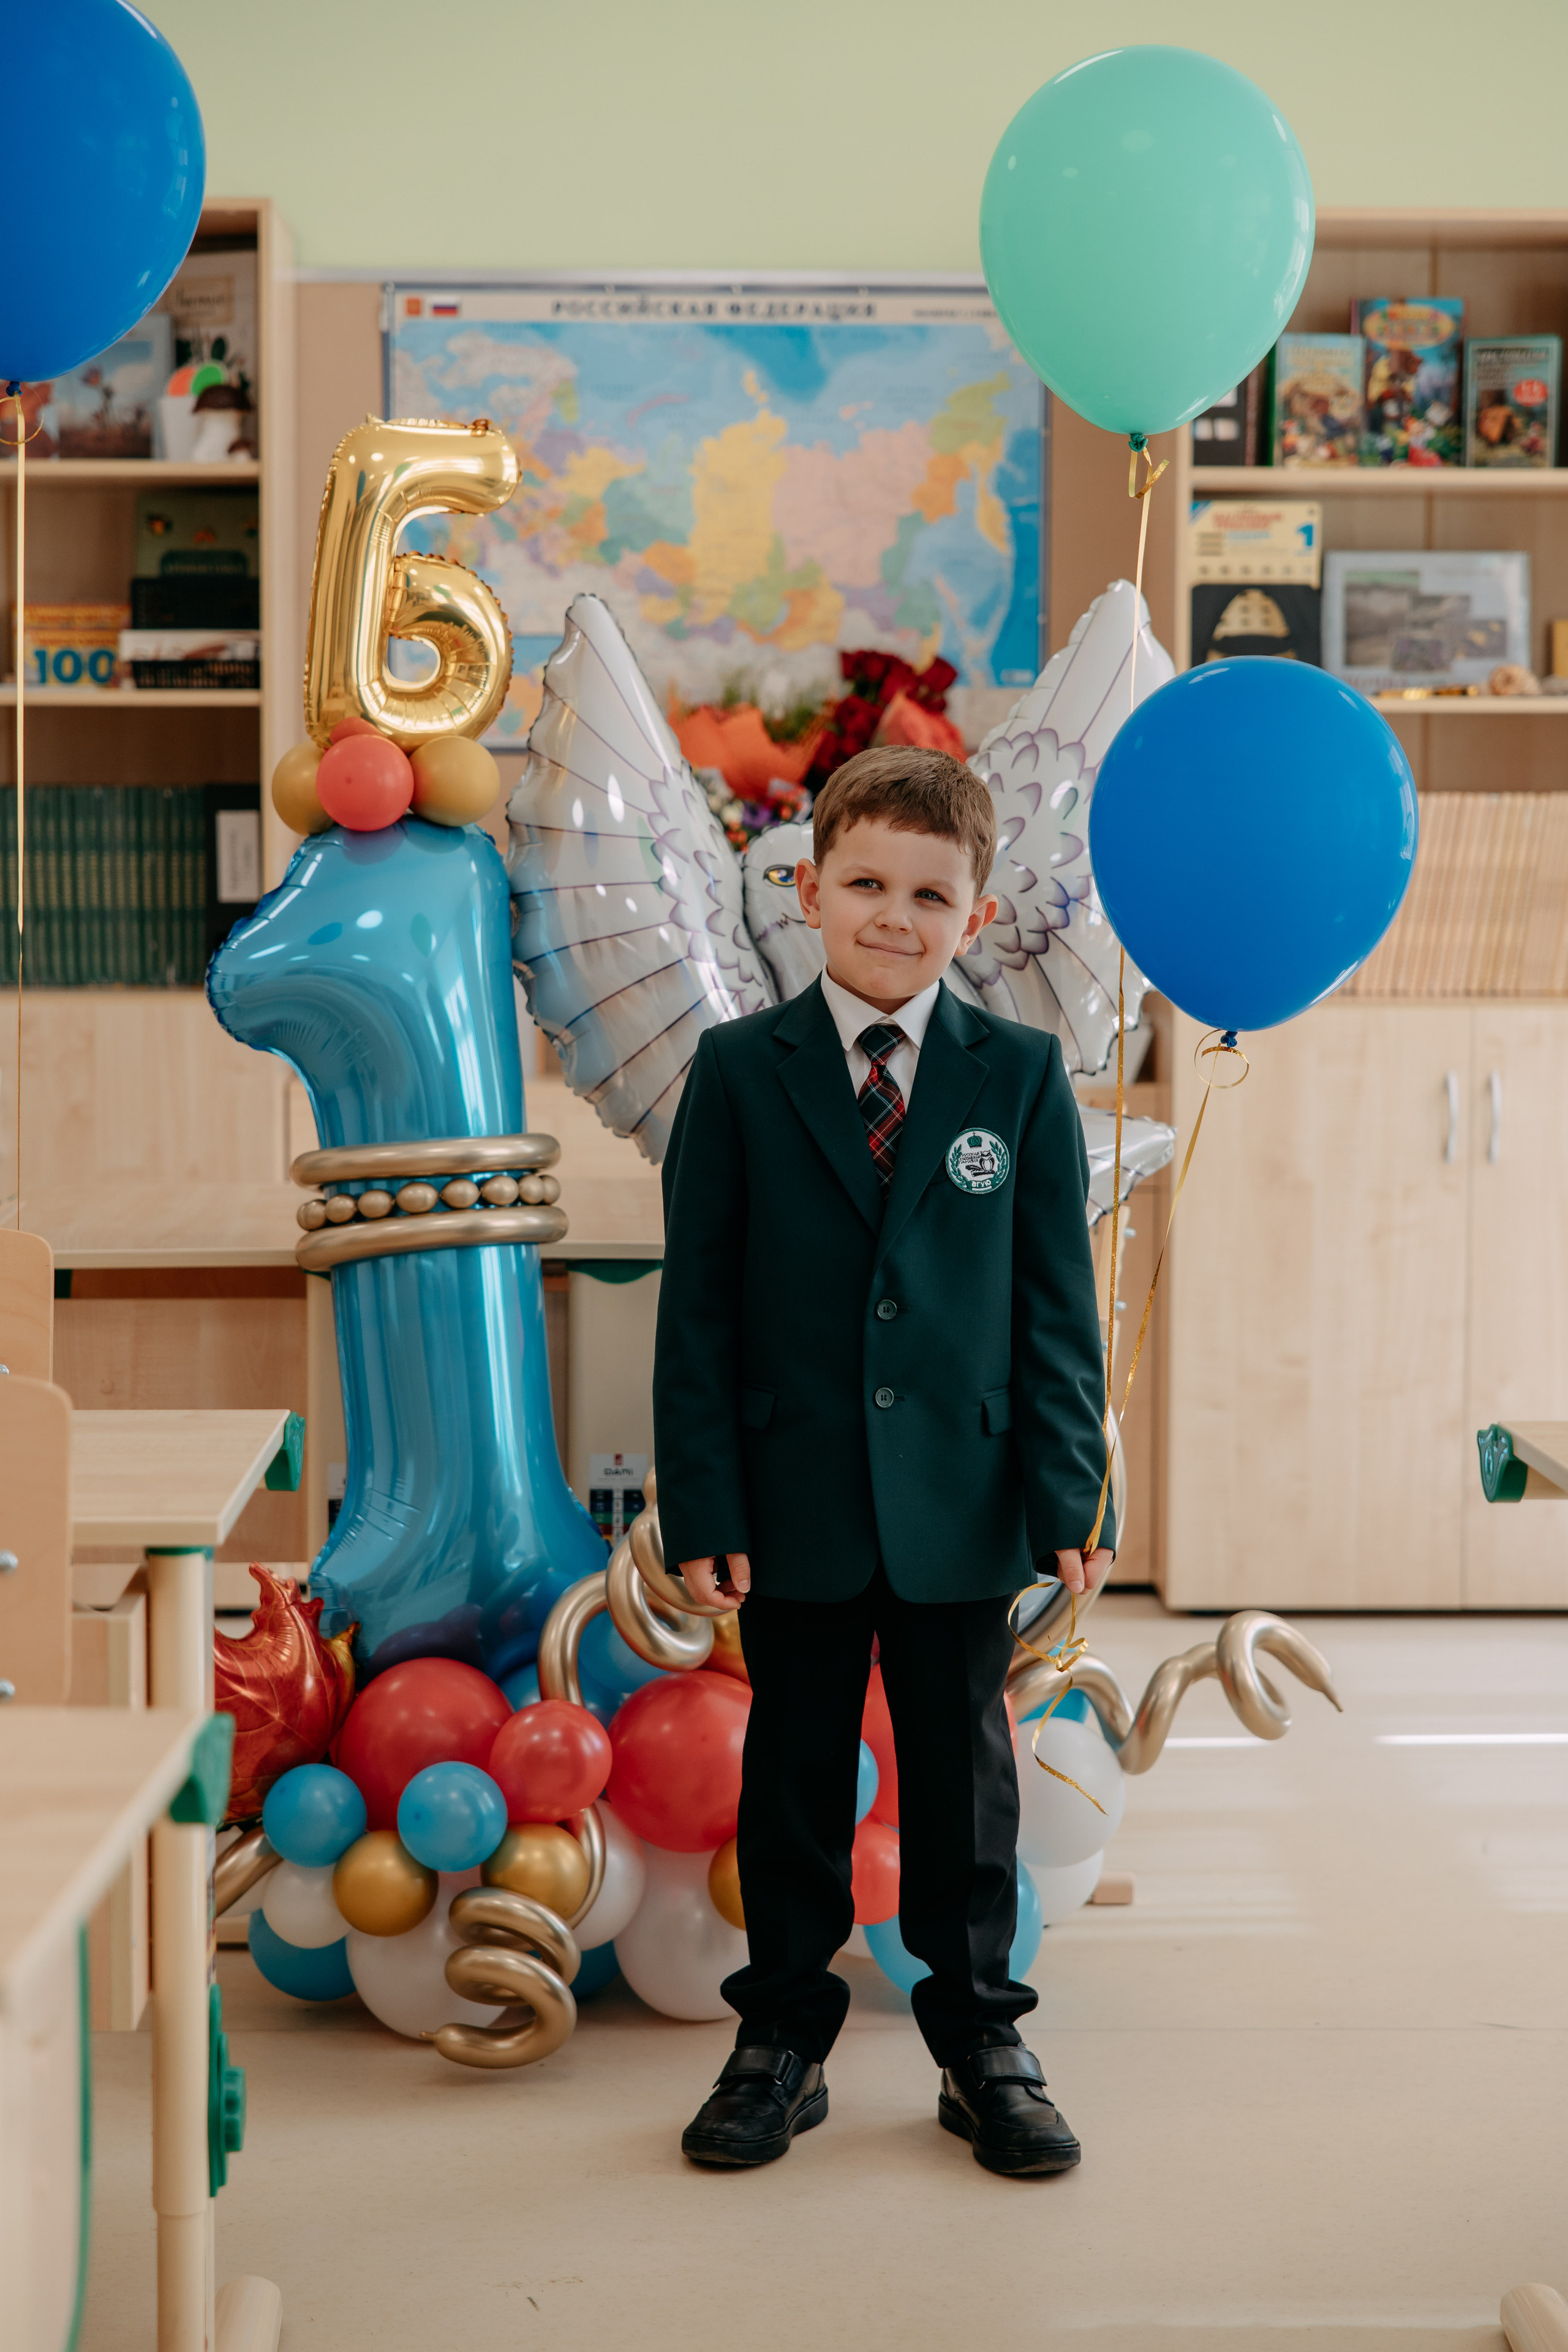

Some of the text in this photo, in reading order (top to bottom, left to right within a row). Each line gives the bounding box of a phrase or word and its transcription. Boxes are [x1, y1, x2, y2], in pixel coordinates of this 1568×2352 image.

[552, 295, 875, 320] РОССИЙСКАЯ ФЕДЕРАЦИЯ
[1297, 522, 1314, 547] 1
[34, 647, 115, 684] 100
[971, 1179, 992, 1188] ВГУЮ
